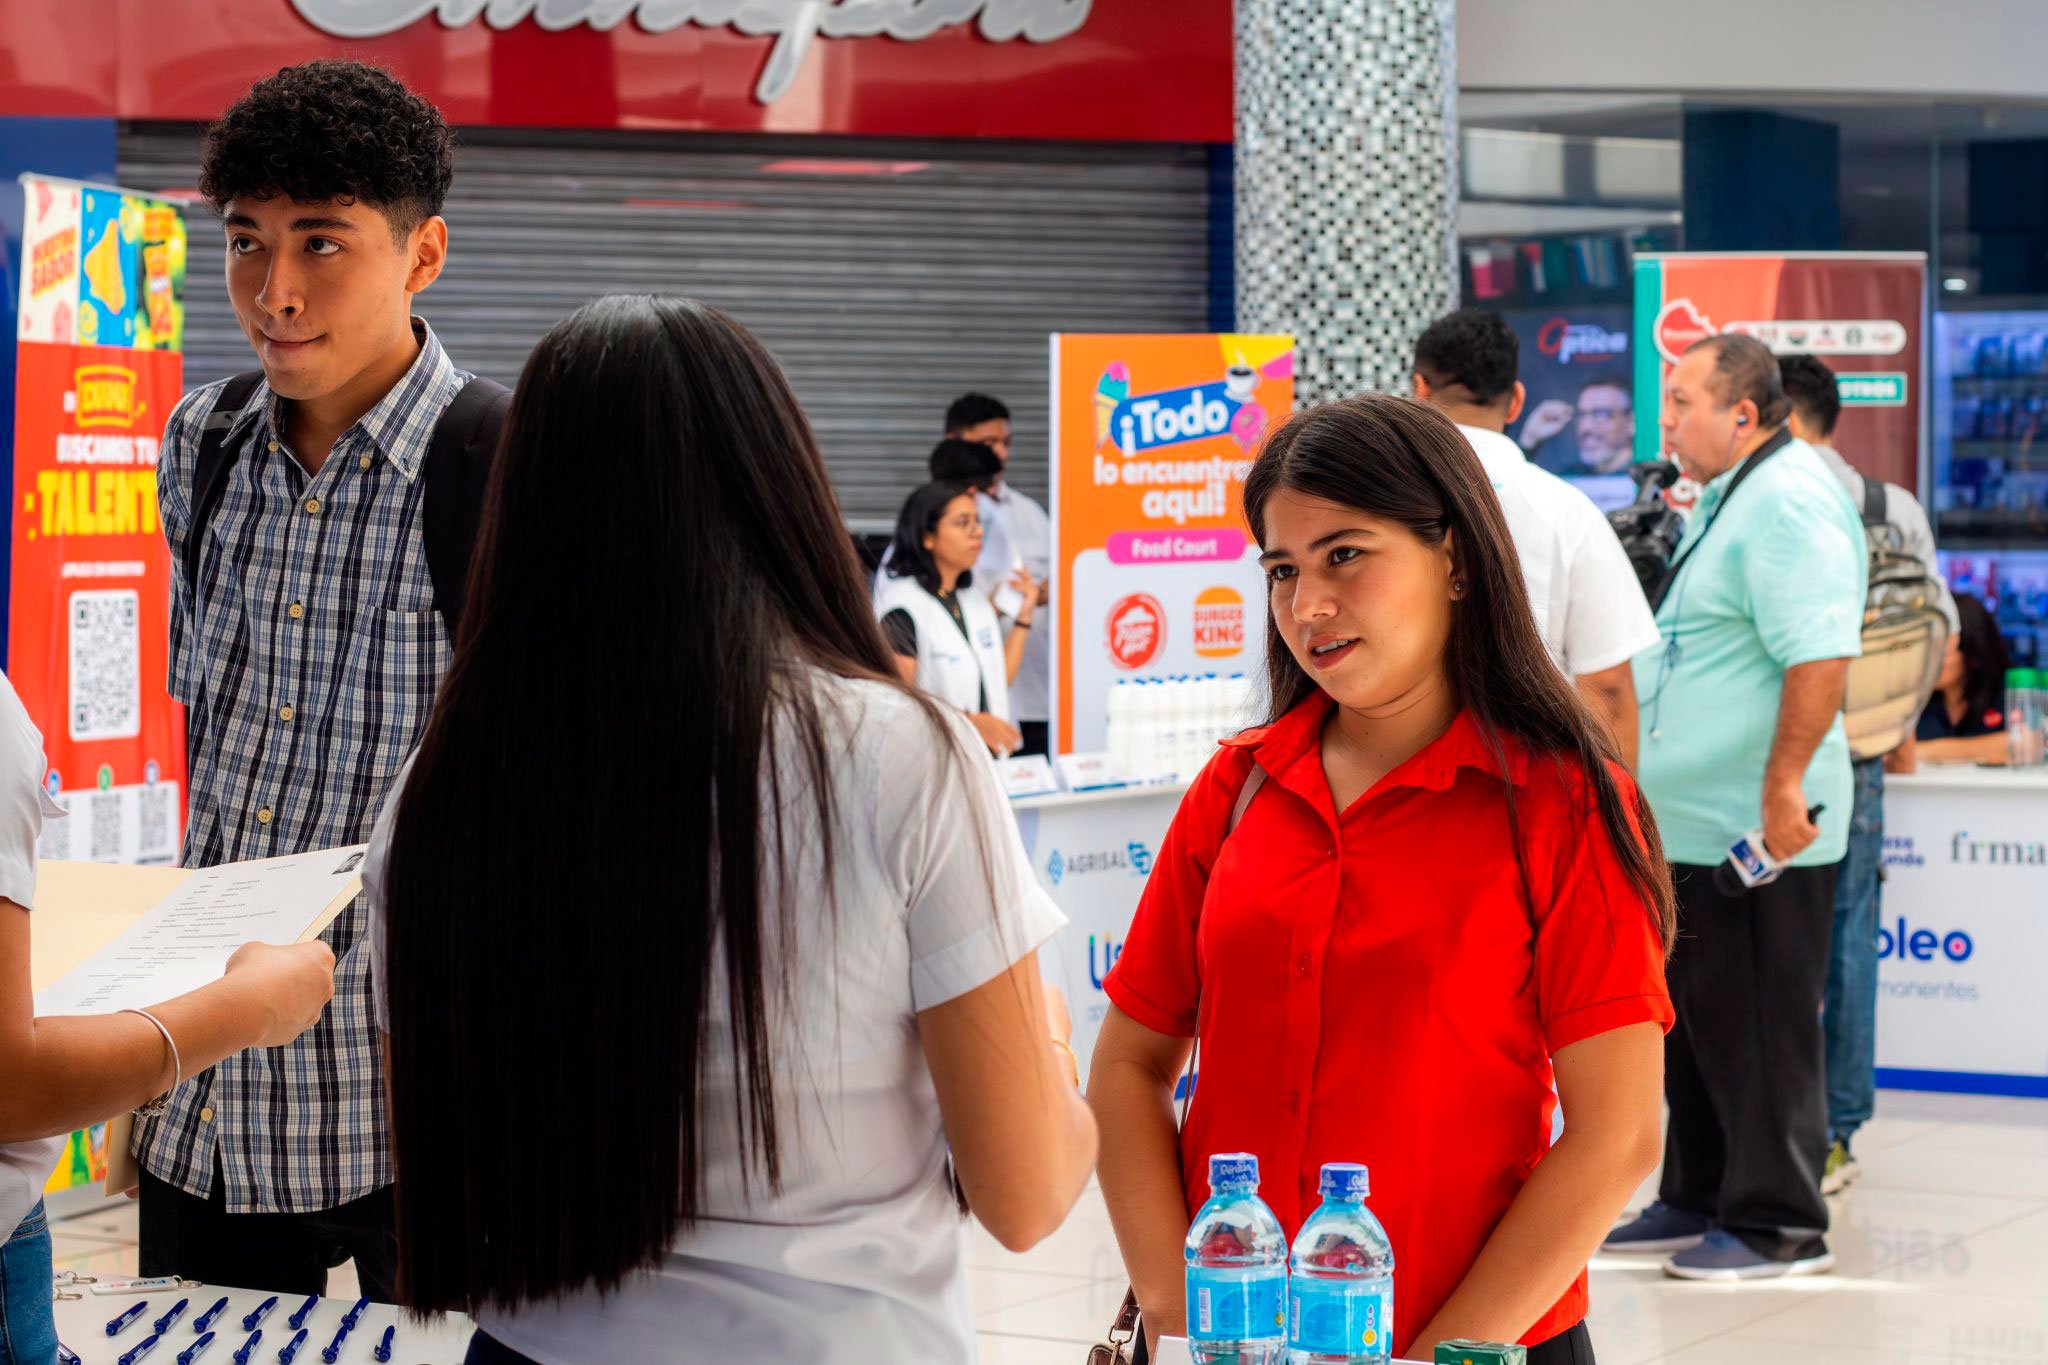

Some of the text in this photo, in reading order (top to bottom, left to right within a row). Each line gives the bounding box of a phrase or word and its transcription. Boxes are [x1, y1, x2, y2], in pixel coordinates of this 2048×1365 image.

[1119, 389, 1229, 457] ¡Todo
[1093, 454, 1252, 485] lo encuentra
[37, 469, 158, 536] TALENT
[1131, 537, 1217, 558] Food Court
[1194, 624, 1244, 643] KING
[1068, 850, 1128, 874] AGRISAL
